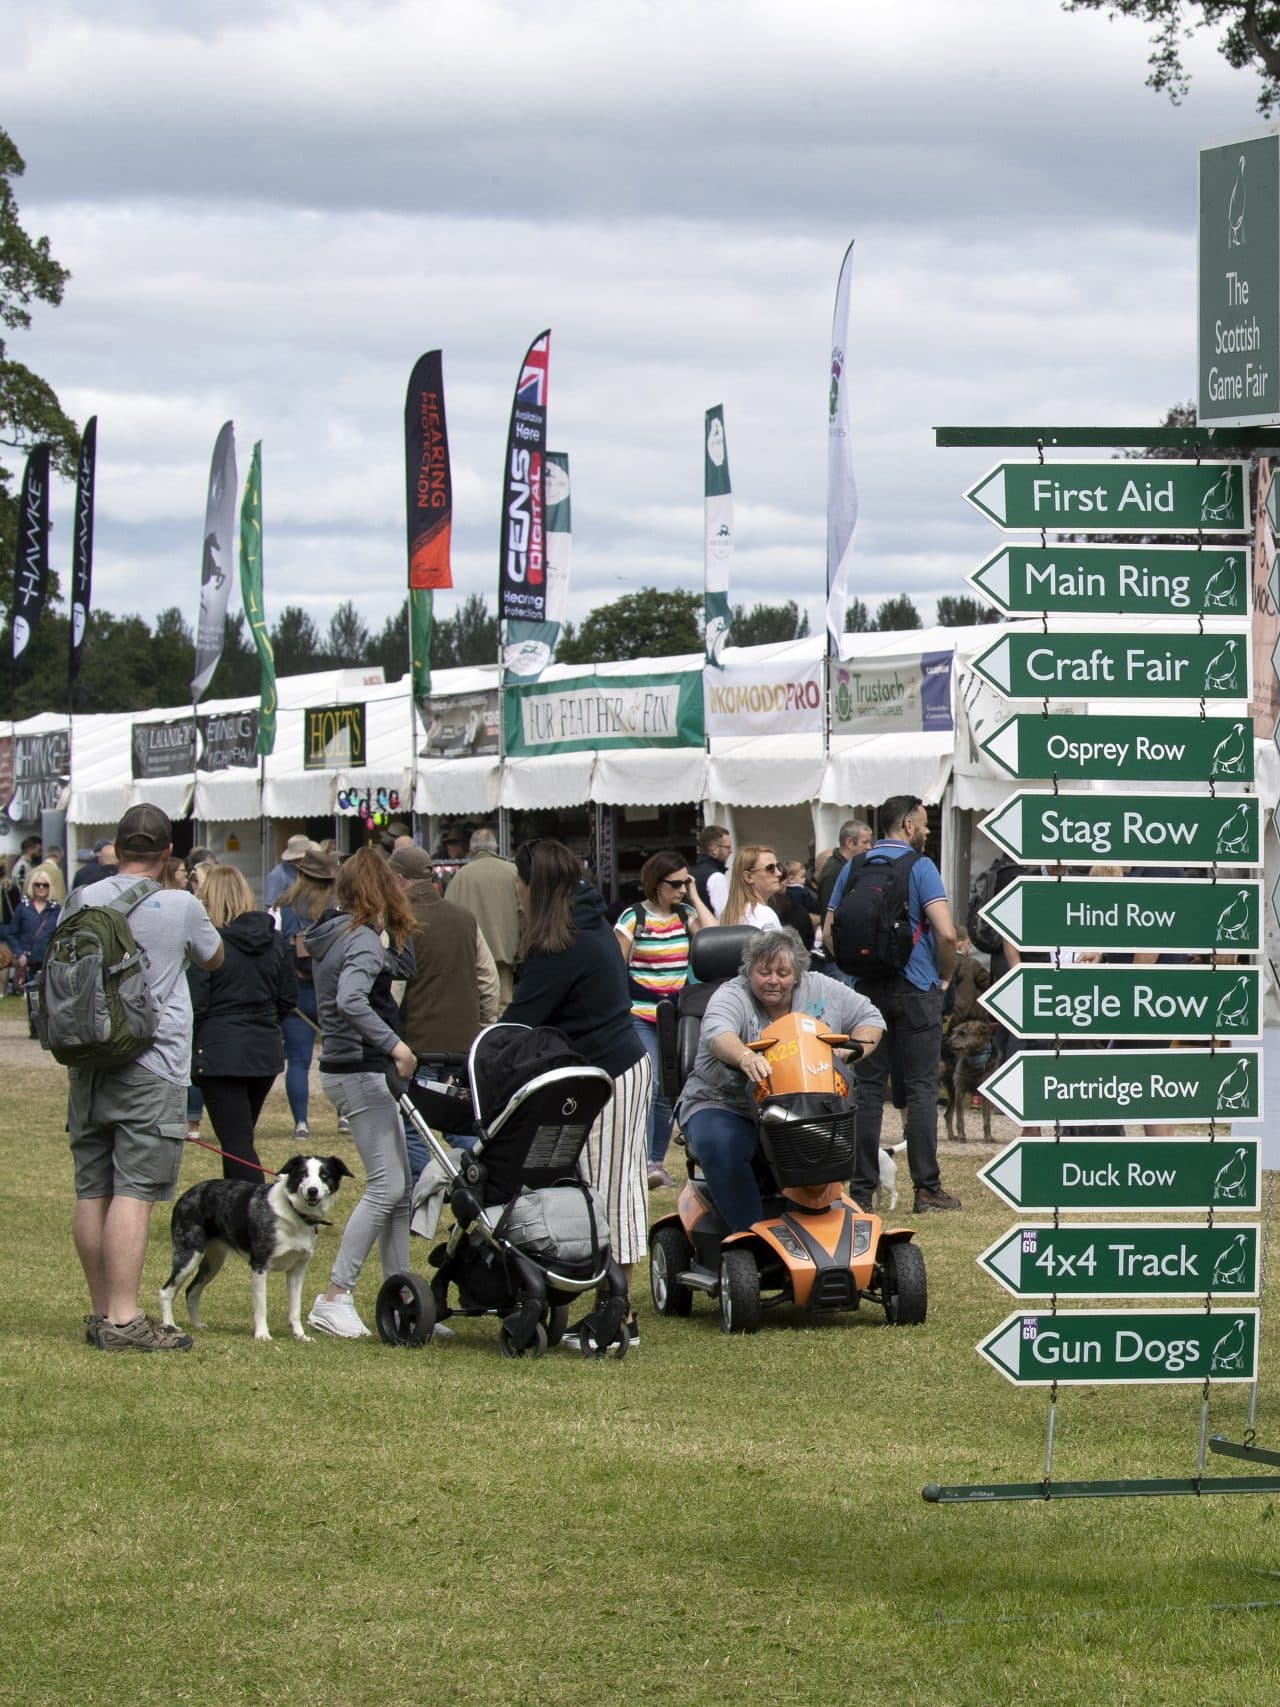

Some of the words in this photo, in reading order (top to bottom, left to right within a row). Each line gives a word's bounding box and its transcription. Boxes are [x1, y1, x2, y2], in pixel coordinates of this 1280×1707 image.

[1226, 272, 1249, 306] The
[1215, 316, 1260, 355] Scottish
[1209, 366, 1242, 401] Game
[1246, 364, 1268, 398] Fair
[417, 391, 430, 508] PROTECTION
[516, 422, 540, 442] Here
[429, 392, 446, 508] HEARING
[1033, 479, 1107, 512] First
[1117, 480, 1174, 512] Aid
[508, 449, 530, 582] CENS
[530, 465, 541, 570] DIGITAL
[18, 479, 42, 606] HAWKE
[1025, 563, 1105, 596] Main
[1119, 565, 1190, 607] Ring
[1026, 649, 1114, 682] Craft
[1127, 650, 1189, 682] Fair
[717, 680, 820, 713] KOMODOPRO
[852, 672, 904, 703] Trustach
[309, 709, 361, 759] HOLTS
[529, 702, 554, 741] FUR
[643, 693, 670, 733] FIN
[1047, 735, 1129, 767] Osprey
[1136, 736, 1185, 761] Row
[1041, 811, 1112, 853] Stag
[1123, 812, 1199, 845] Row
[1066, 903, 1118, 927] Hind
[1127, 903, 1175, 927] Row
[1033, 985, 1121, 1027] Eagle
[1134, 985, 1208, 1018] Row
[1044, 1075, 1143, 1106] Partridge
[1150, 1075, 1199, 1098] Row
[1063, 1163, 1120, 1186] Duck
[1127, 1163, 1176, 1186] Row
[1022, 1240, 1037, 1253] GO
[1035, 1244, 1097, 1276] 4x4
[1108, 1244, 1199, 1276] Track
[1022, 1328, 1037, 1340] GO
[1032, 1332, 1101, 1364] Gun
[1115, 1331, 1200, 1372] Dogs
